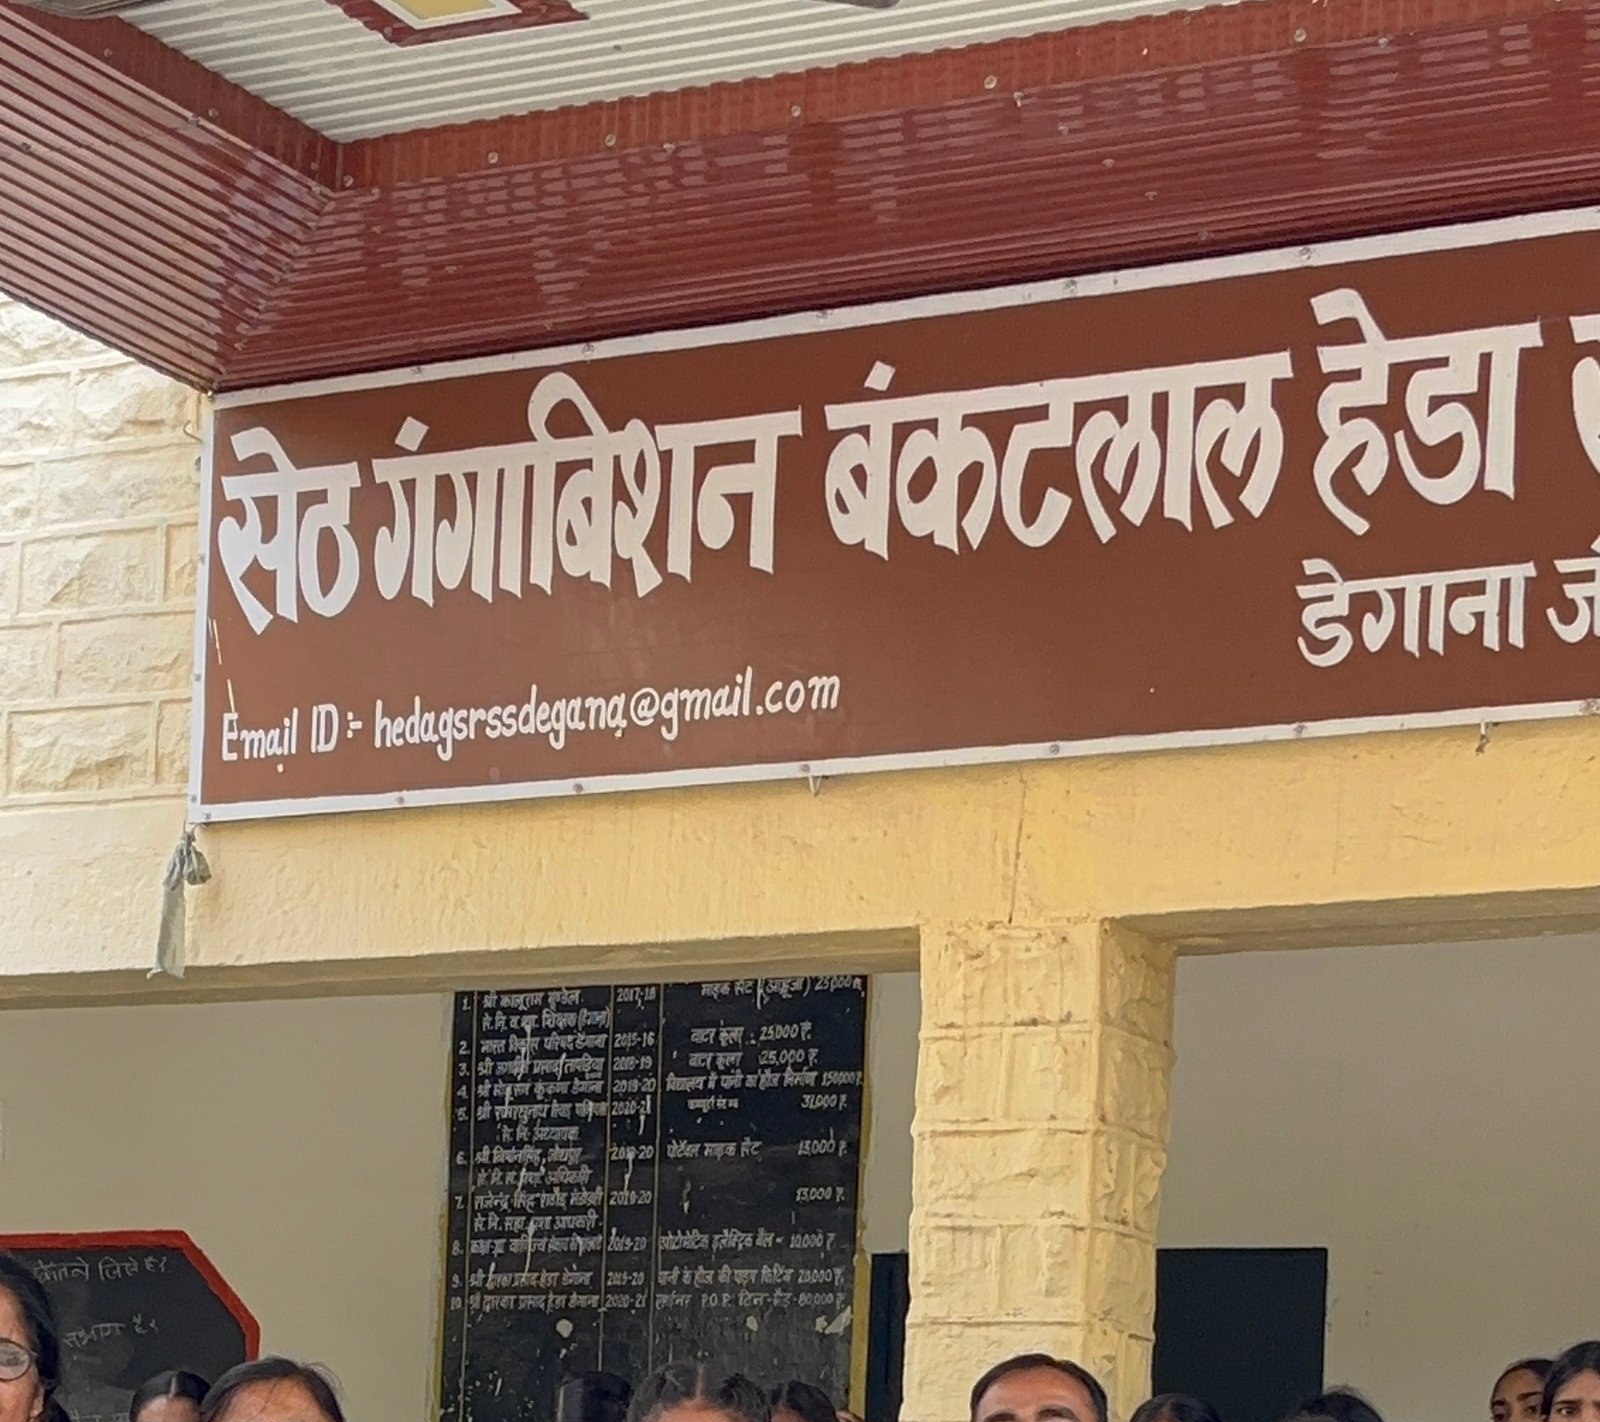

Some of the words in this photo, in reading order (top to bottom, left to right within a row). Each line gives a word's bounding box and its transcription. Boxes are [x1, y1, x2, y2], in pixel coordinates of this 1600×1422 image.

[218, 426, 361, 635] सेठ
[372, 371, 802, 607] गंगाबिशन
[825, 349, 1293, 560] बंकटलाल
[1310, 288, 1543, 535] हेडा
[1296, 558, 1537, 667] डेगाना
[222, 709, 297, 761] Email
[375, 666, 841, 761] hedagsrssdegana@gmail.com
